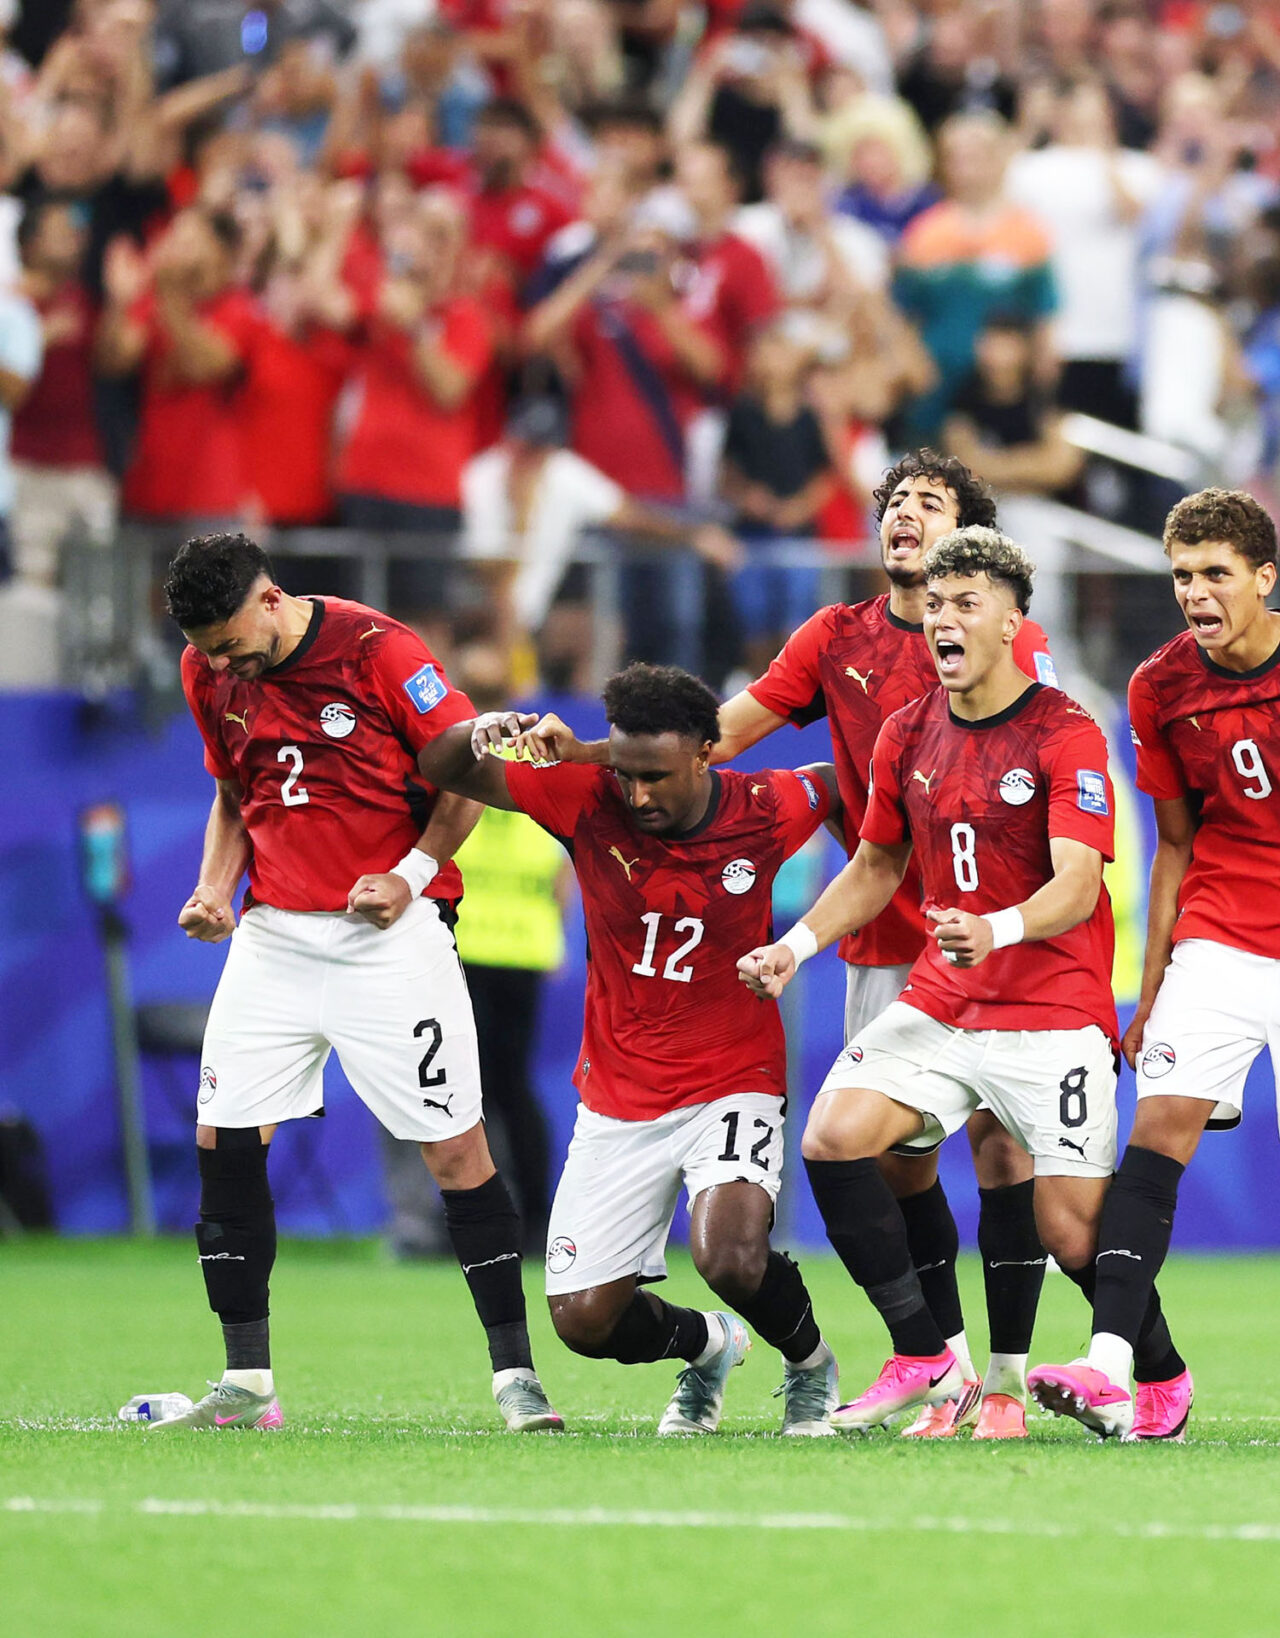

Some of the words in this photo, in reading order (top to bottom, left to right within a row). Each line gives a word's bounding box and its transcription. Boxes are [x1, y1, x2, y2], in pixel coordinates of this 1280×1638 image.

[277, 745, 310, 807] 2
[1231, 738, 1273, 800] 9
[950, 822, 979, 893] 8
[631, 911, 705, 983] 12
[413, 1017, 447, 1088] 2
[1059, 1065, 1089, 1129] 8
[717, 1110, 774, 1172] 12
